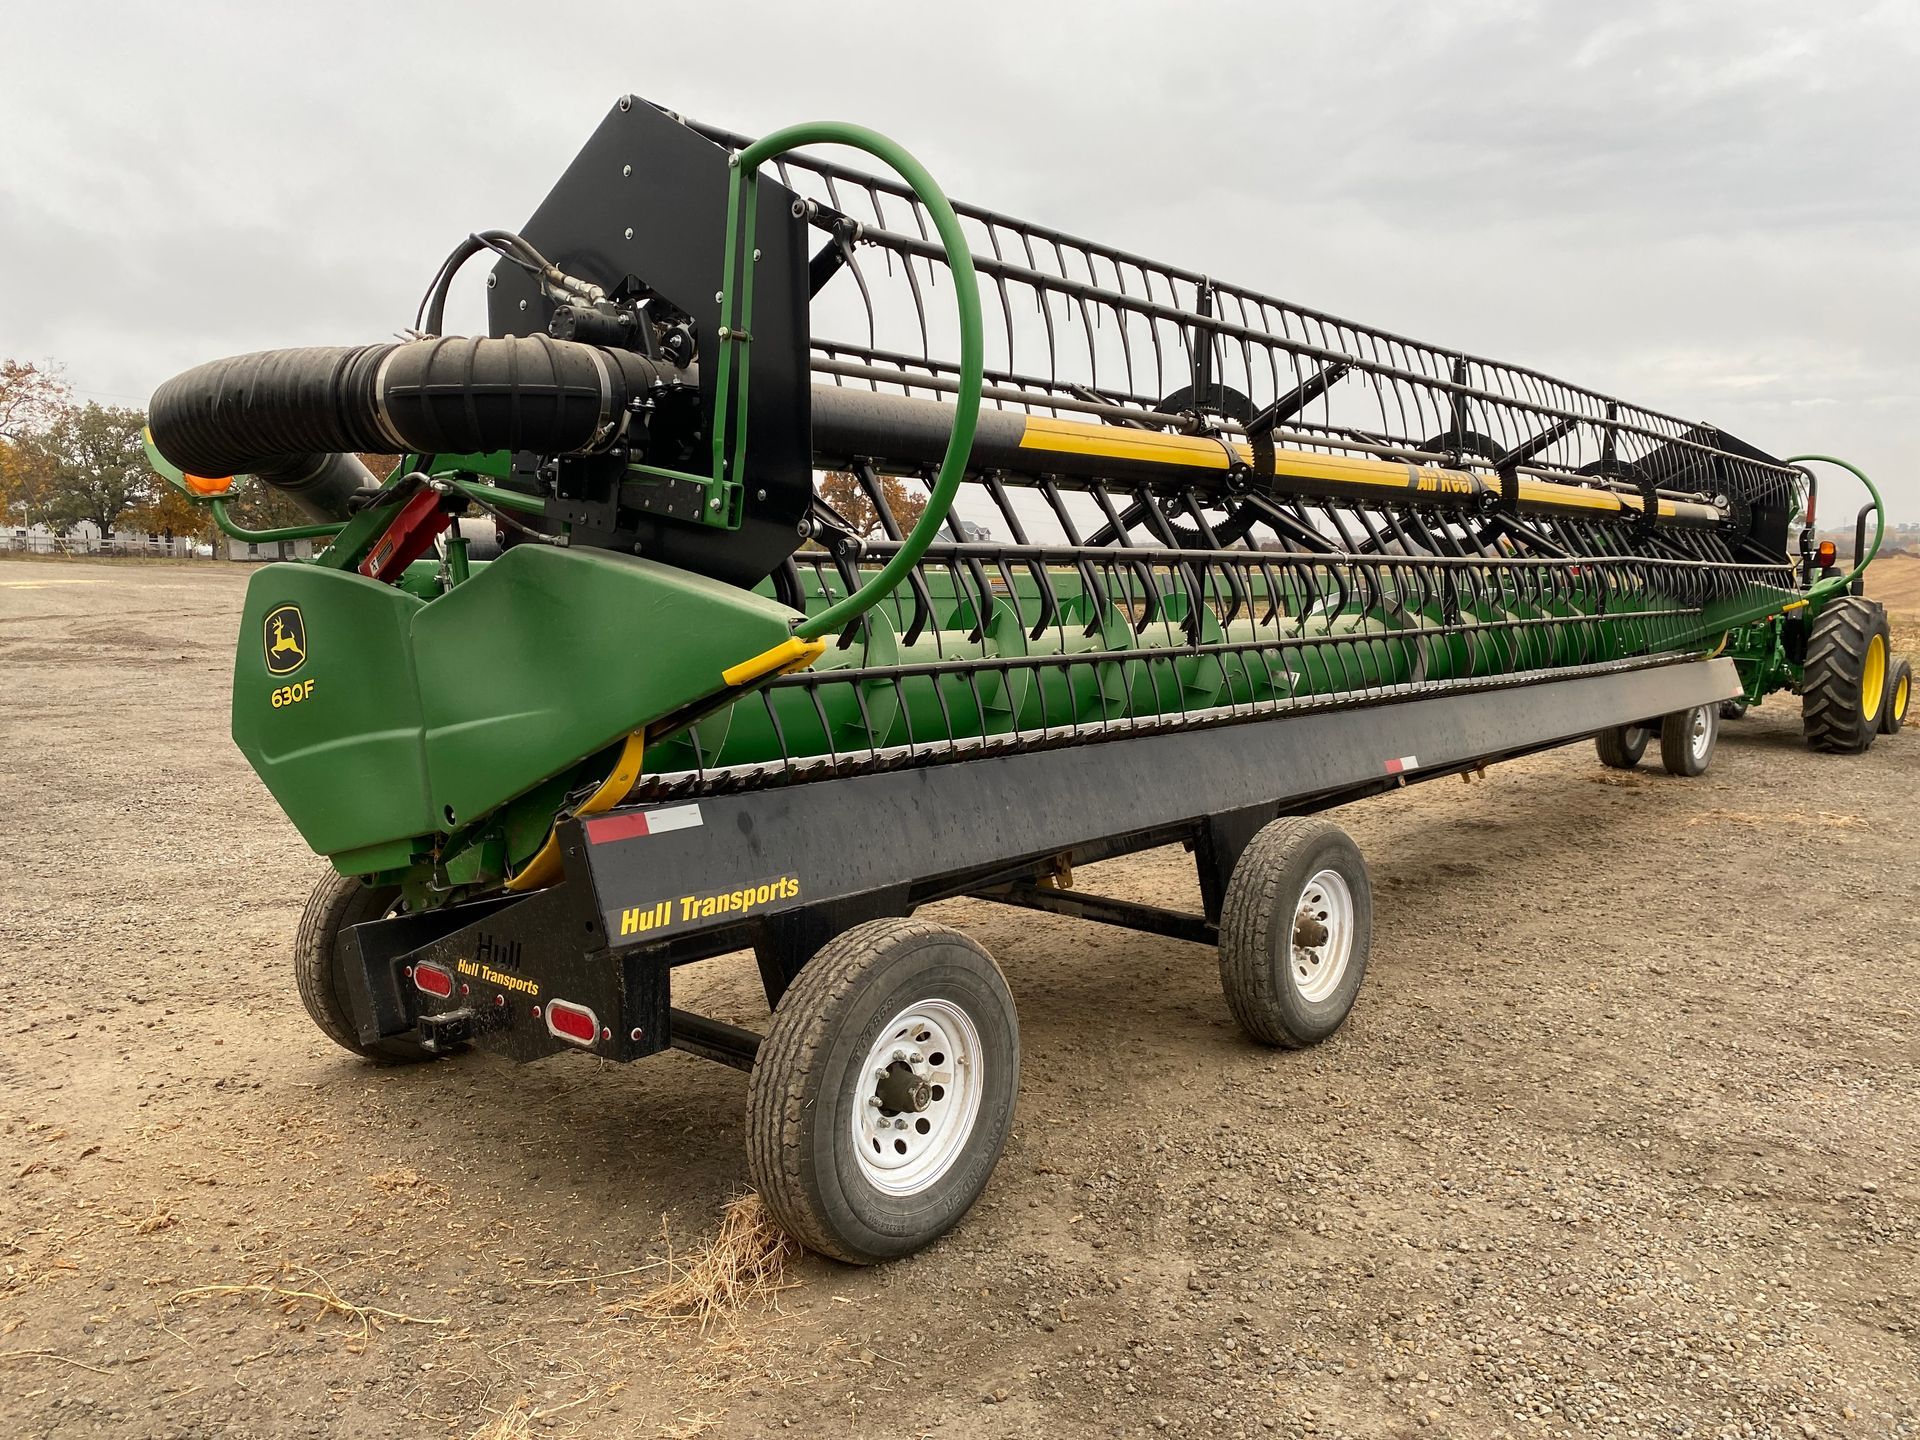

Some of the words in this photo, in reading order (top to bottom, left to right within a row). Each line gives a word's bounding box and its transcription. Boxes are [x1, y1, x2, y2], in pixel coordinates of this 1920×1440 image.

[271, 679, 315, 709] 630F
[620, 901, 672, 936] Hull
[679, 876, 799, 922] Transports
[476, 932, 522, 972] Hull
[457, 958, 479, 977] Hull
[482, 966, 540, 996] Transports
[944, 1103, 1007, 1214] CONTENDER
